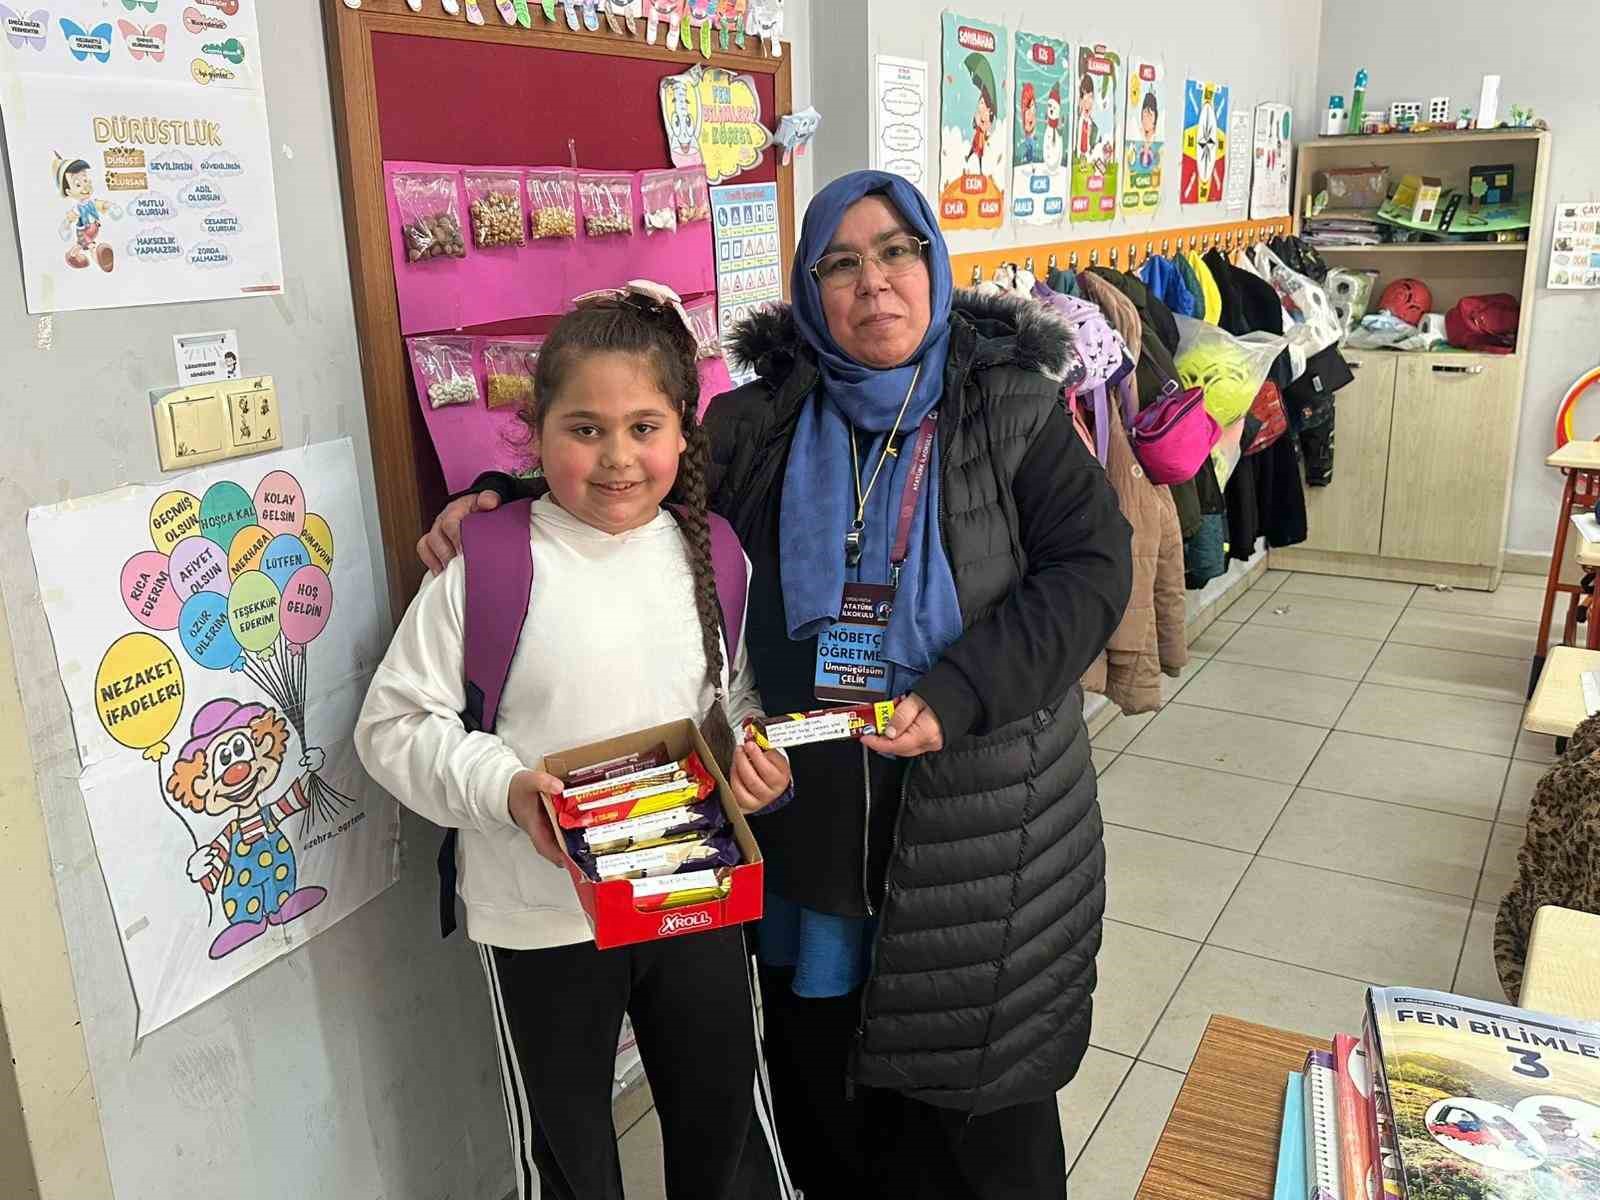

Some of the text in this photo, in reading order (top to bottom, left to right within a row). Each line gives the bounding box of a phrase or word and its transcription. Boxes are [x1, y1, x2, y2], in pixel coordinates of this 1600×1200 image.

[93, 115, 223, 146] DÜRÜSTLÜK
[106, 154, 140, 164] DÜRÜST
[150, 161, 193, 171] SEVİLİRSİN
[110, 176, 145, 187] OLURSAN
[195, 185, 212, 194] ADİL
[138, 199, 165, 208] MUTLU
[188, 193, 221, 202] OLURSUN
[136, 208, 169, 216] OLURSUN
[204, 217, 238, 226] CESARETLİ
[207, 225, 236, 233] OLURSUN
[137, 236, 176, 246] HAKSIZLIK
[134, 246, 180, 256] YAPMAZSIN
[192, 254, 228, 264] KALMAZSIN
[264, 491, 295, 505] KOLAY
[152, 495, 193, 530] GEÇMİŞ
[236, 507, 256, 521] KAL
[262, 508, 295, 523] GELSİN
[164, 512, 200, 544] OLSUN
[231, 534, 271, 576] MERHABA
[265, 553, 303, 570] LÜTFEN
[178, 547, 214, 584] AFİYET
[189, 562, 223, 596] OLSUN
[141, 570, 169, 618] EDERİM
[297, 583, 319, 601] HOŞ
[233, 596, 277, 620] TEŞEKKÜR
[287, 600, 322, 619] GELDİN
[841, 610, 874, 619] İLKOKULU
[843, 602, 873, 611] ATATÜRK
[189, 609, 212, 639] ÖZÜR
[239, 613, 274, 633] EDERİM
[828, 627, 882, 649] NÖBETÇ
[819, 642, 881, 661] ÖĞRETME
[99, 658, 174, 703] NEZAKET
[841, 674, 865, 684] ÇELİK
[105, 679, 182, 727] İFADELERİ
[661, 914, 708, 933] XROLL
[1397, 1009, 1459, 1029] FEN
[1469, 1021, 1600, 1059] BİLİMLE
[1506, 1045, 1550, 1079] 3
